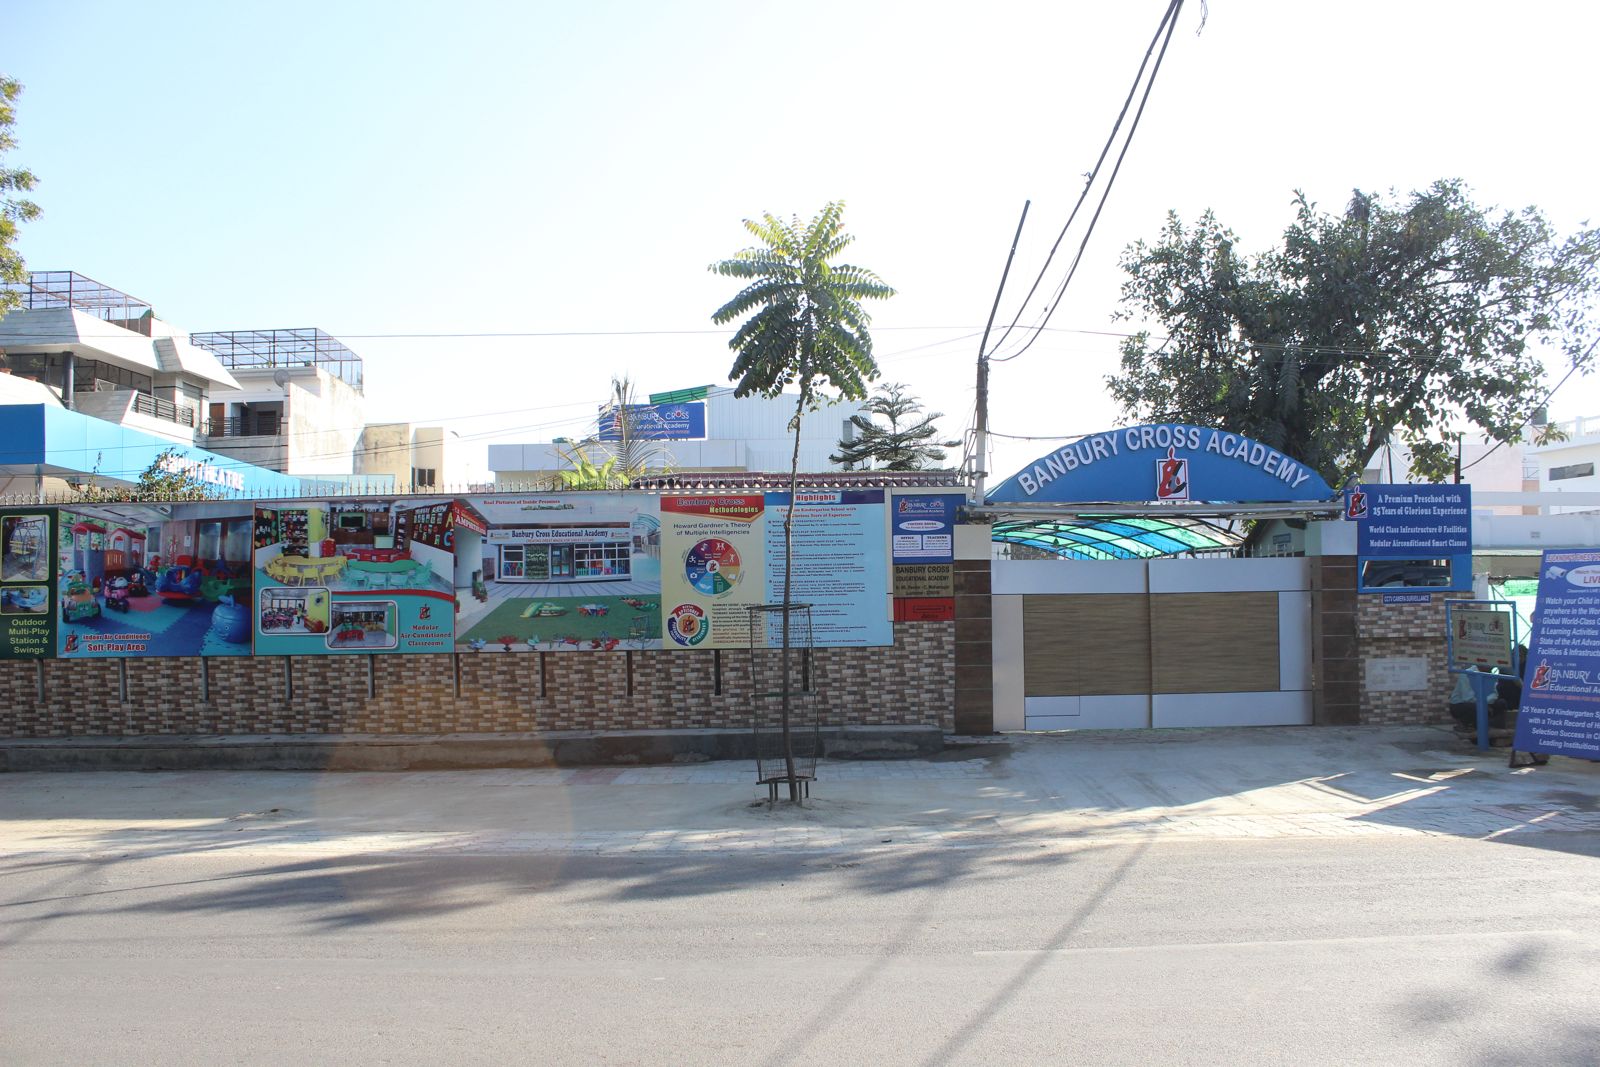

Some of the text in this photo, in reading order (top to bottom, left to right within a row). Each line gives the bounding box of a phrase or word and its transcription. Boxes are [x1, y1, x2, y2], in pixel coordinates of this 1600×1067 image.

[1017, 425, 1310, 496] BANBURY CROSS ACADEMY
[795, 494, 836, 502] Highlights
[1377, 494, 1461, 503] A Premium Preschool with
[1381, 507, 1396, 515] Years
[1404, 507, 1432, 515] Glorious
[1432, 507, 1467, 517] Experience
[1368, 525, 1385, 533] World
[1385, 525, 1399, 533] Class
[1400, 525, 1437, 533] Infrastructure
[1443, 525, 1467, 533] Facilities
[511, 530, 534, 539] Banbury
[535, 530, 551, 538] Cross
[551, 529, 583, 538] Educational
[584, 529, 609, 538] Academy
[1369, 539, 1467, 547] Modular Airconditioned Smart Classes
[896, 565, 950, 574] BANBURY CROSS
[1545, 597, 1562, 605] Watch
[1563, 598, 1577, 606] your
[1577, 597, 1593, 605] Child
[1543, 608, 1571, 617] anywhere
[1578, 607, 1586, 615] the
[11, 618, 47, 627] Outdoor
[1542, 617, 1560, 625] Global
[1561, 617, 1595, 625] World-Class
[8, 627, 50, 637] Multi-Play
[1546, 627, 1572, 636] Learning
[1572, 627, 1599, 635] Activities
[9, 637, 40, 645] Station
[1539, 637, 1554, 645] State
[1554, 637, 1561, 645] of
[1561, 637, 1570, 645] the
[13, 646, 45, 655] Swings
[87, 643, 147, 652] Soft Play Area
[1537, 647, 1562, 656] Facilities
[1551, 669, 1591, 681] BANBURY
[1550, 683, 1591, 693] Educational
[1521, 705, 1530, 713] 25
[1530, 706, 1546, 714] Years
[1555, 708, 1594, 718] Kindergarten
[1547, 718, 1562, 726] Track
[1563, 719, 1586, 728] Record
[1531, 727, 1559, 737] Selection
[1559, 729, 1585, 738] Success
[1585, 731, 1592, 739] in
[1538, 738, 1563, 748] Leading
